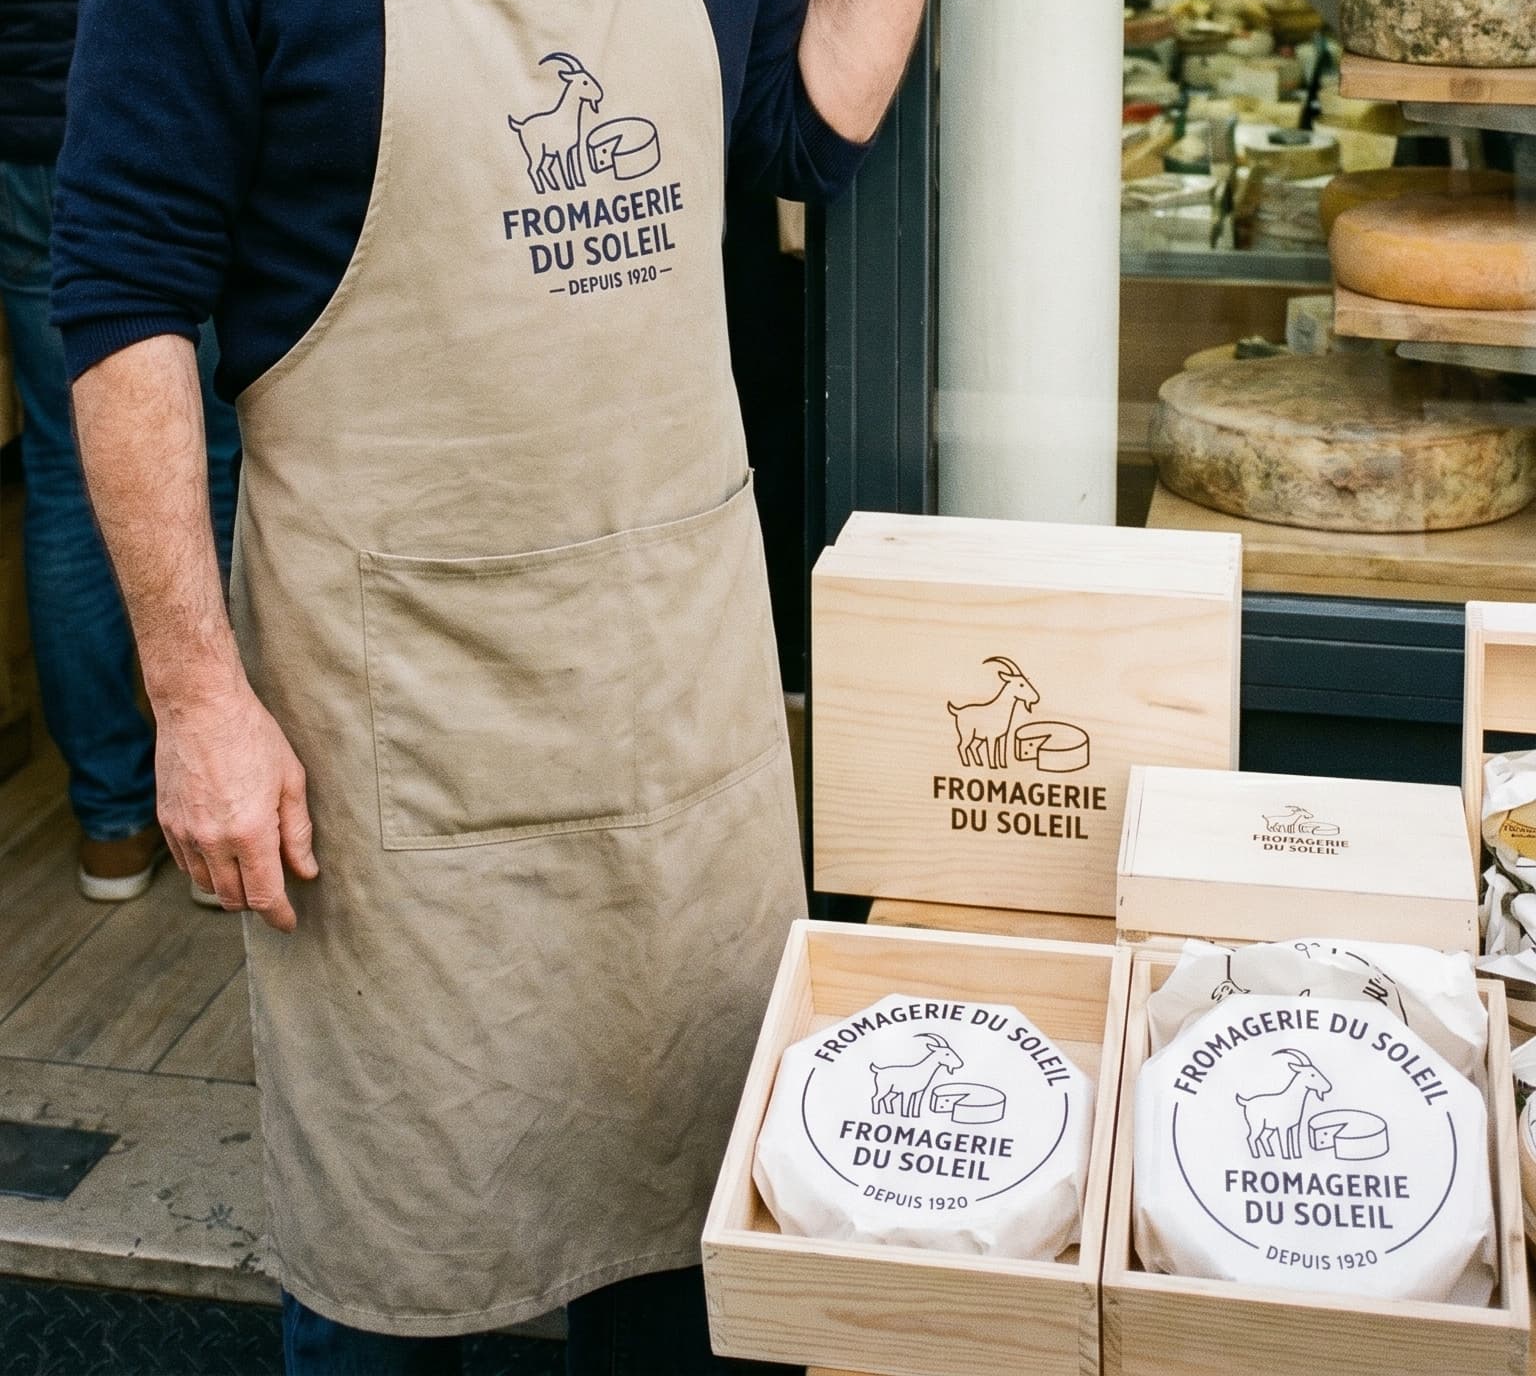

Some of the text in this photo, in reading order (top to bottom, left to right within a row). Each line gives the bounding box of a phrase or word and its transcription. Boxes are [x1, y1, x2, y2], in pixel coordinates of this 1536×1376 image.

[503, 182, 683, 240] FROMAGERIE
[529, 223, 676, 274] DU SOLEIL
[568, 265, 657, 295] DEPUIS 1920
[933, 775, 1107, 810] FROMAGERIE
[951, 807, 1089, 840] DU SOLEIL
[1263, 843, 1339, 855] DU SOLEIL
[814, 1003, 1071, 1087] FROMAGERIE DU SOLEIL
[1173, 1009, 1449, 1106] FROMAGERIE DU SOLEIL
[839, 1120, 1014, 1158] FROMAGERIE
[852, 1146, 990, 1181] DU SOLEIL
[863, 1184, 968, 1210] DEPUIS 1920
[1225, 1169, 1410, 1199] FROMAGERIE
[1245, 1200, 1393, 1229] DU SOLEIL
[1266, 1245, 1378, 1270] DEPUIS 1920
